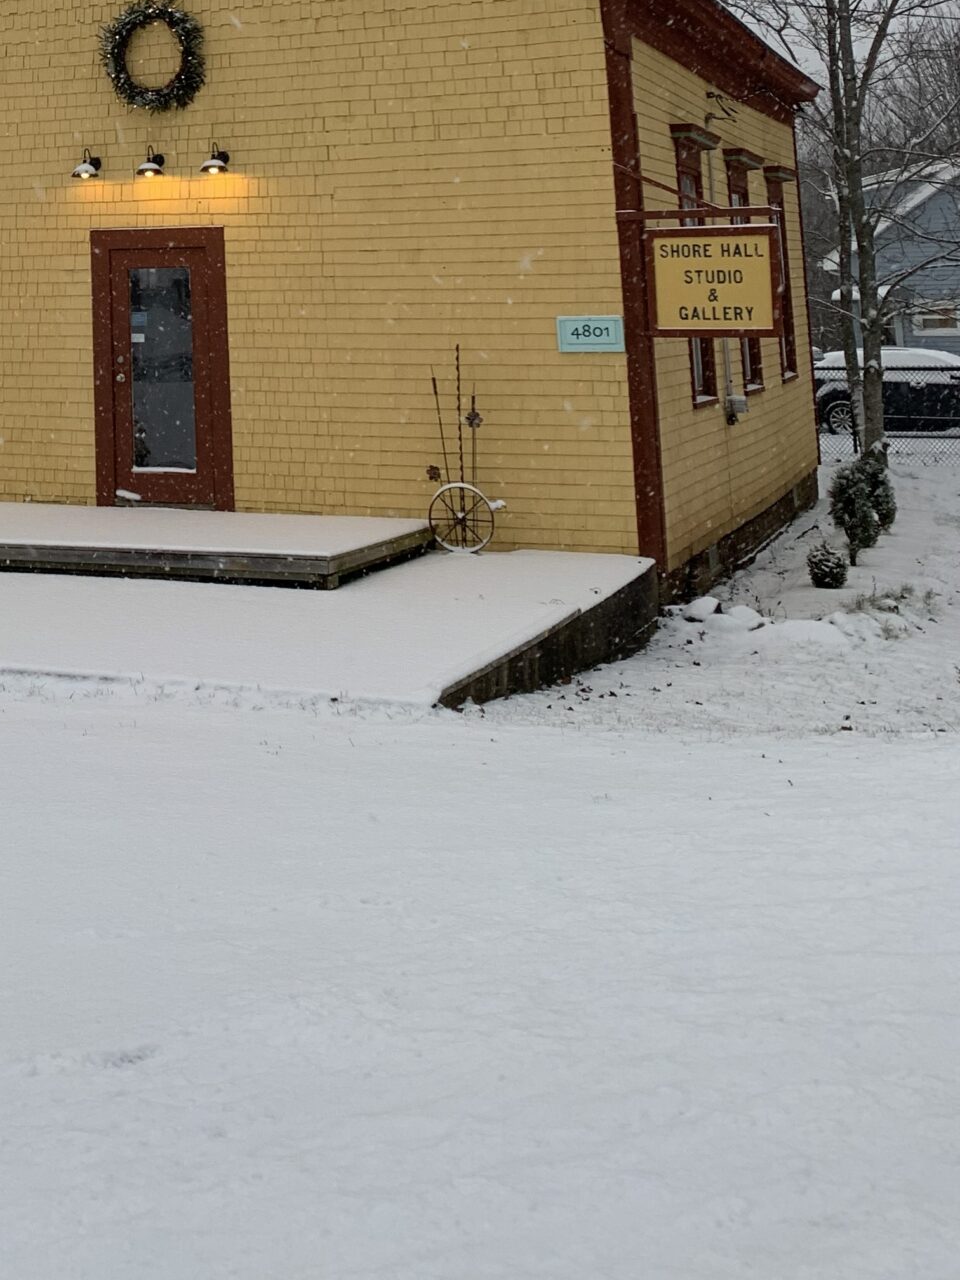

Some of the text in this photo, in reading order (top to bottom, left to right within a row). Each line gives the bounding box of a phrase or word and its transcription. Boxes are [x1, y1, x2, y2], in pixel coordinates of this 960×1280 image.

[660, 243, 764, 258] SHORE HALL
[684, 269, 743, 284] STUDIO
[708, 288, 719, 302] &
[679, 306, 754, 321] GALLERY
[570, 324, 610, 340] 4801
